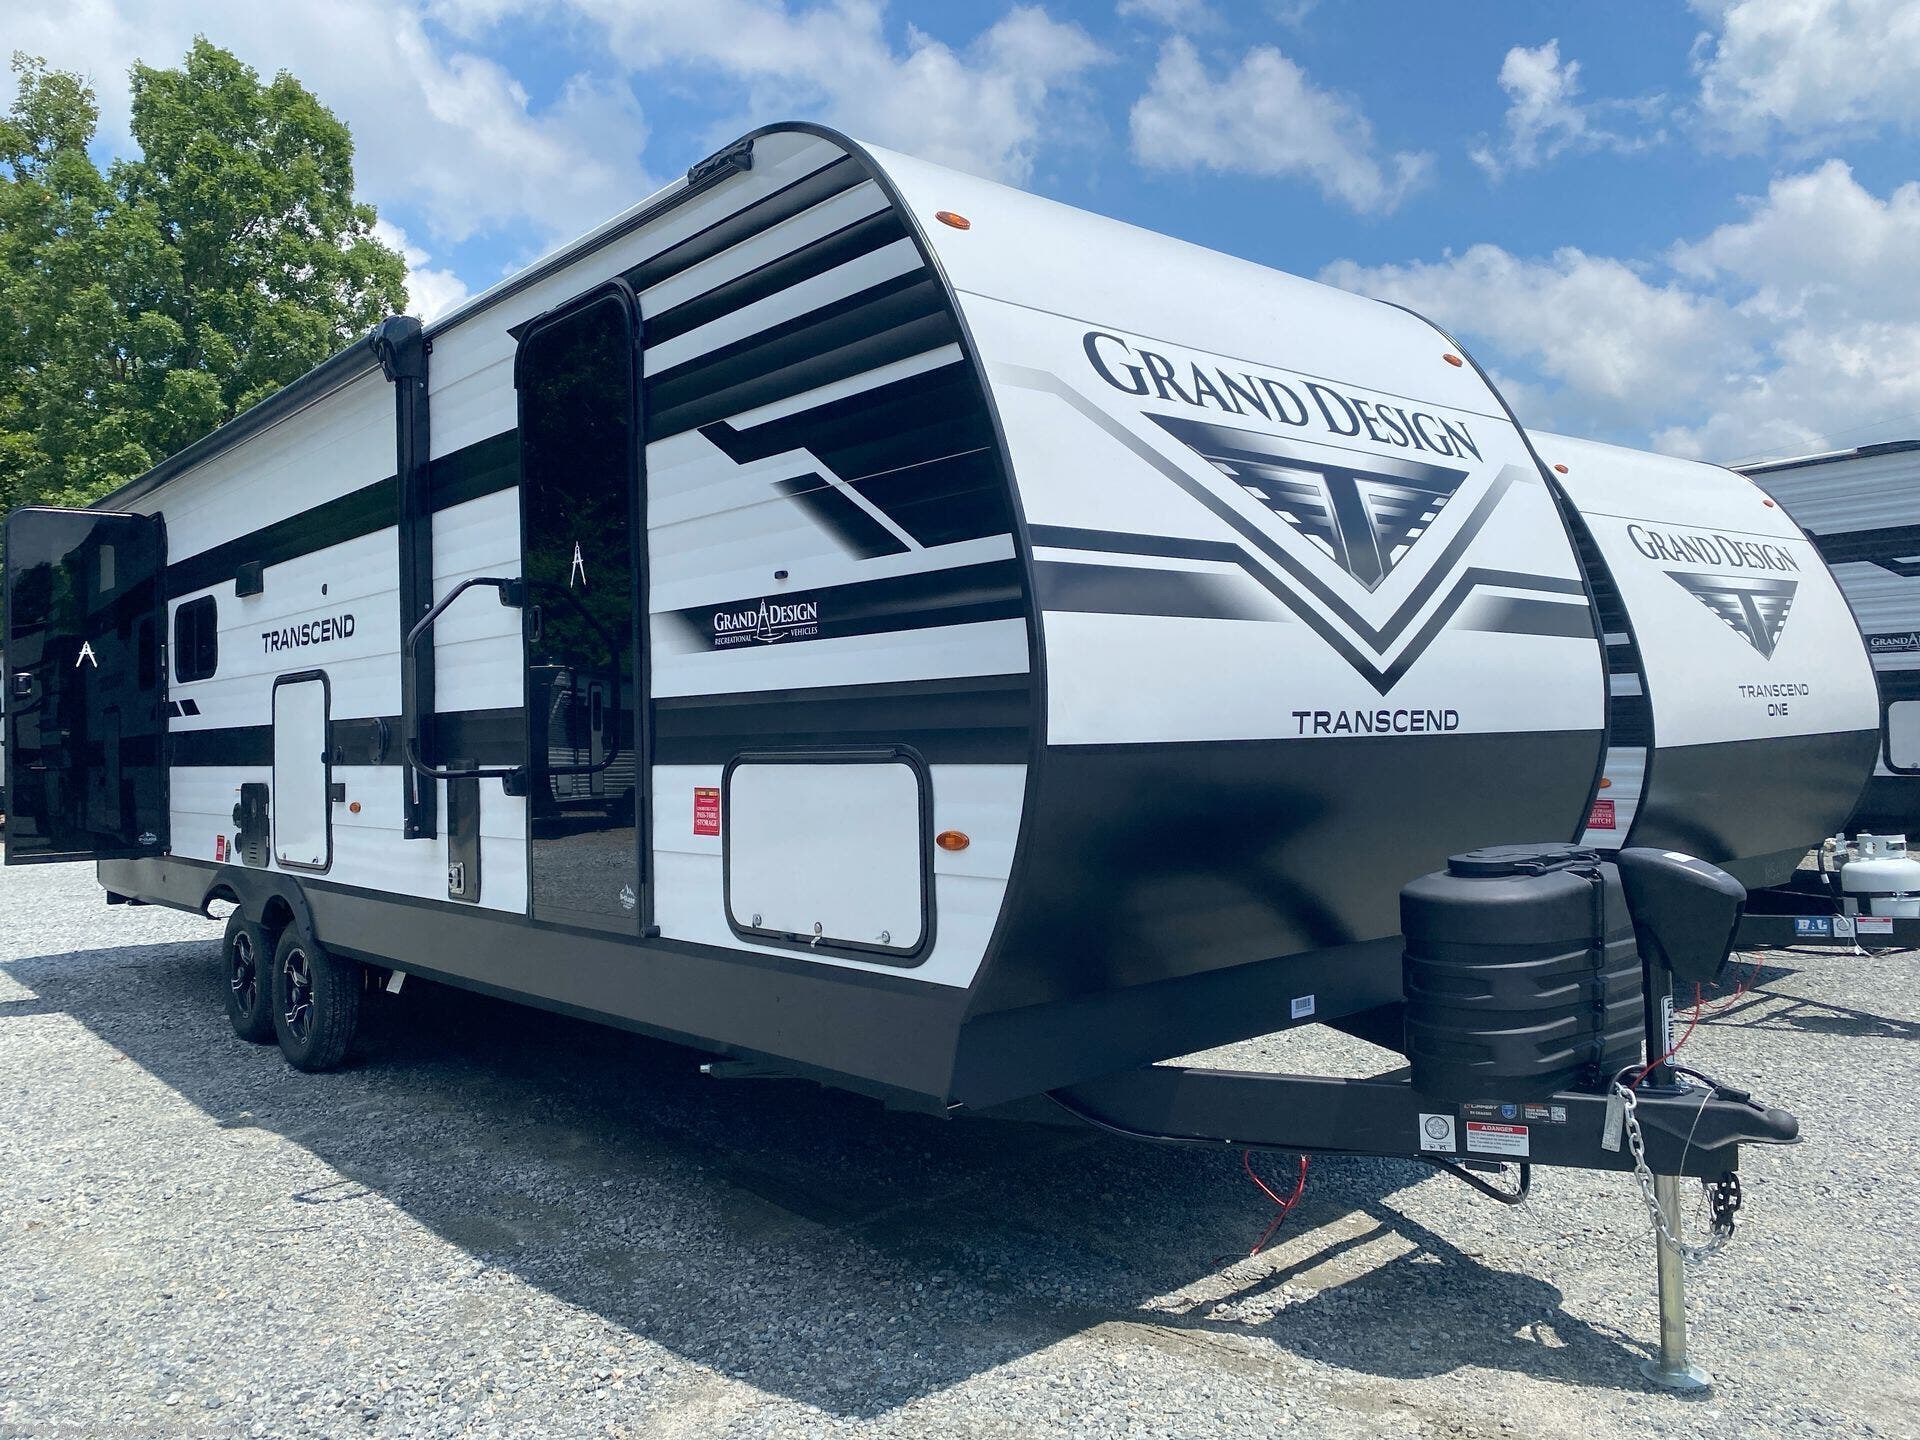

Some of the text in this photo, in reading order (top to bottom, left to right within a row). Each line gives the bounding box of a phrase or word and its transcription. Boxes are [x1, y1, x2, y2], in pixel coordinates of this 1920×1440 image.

[1083, 331, 1484, 463] GRAND DESIGN
[1626, 524, 1801, 572] GRAND DESIGN
[714, 602, 818, 631] GRAND DESIGN
[261, 614, 355, 654] TRANSCEND
[714, 626, 818, 646] RECREATIONAL VEHICLES
[1870, 637, 1908, 646] GRAND
[1738, 683, 1810, 698] TRANSCEND
[1292, 709, 1459, 735] TRANSCEND
[1767, 703, 1789, 717] ONE
